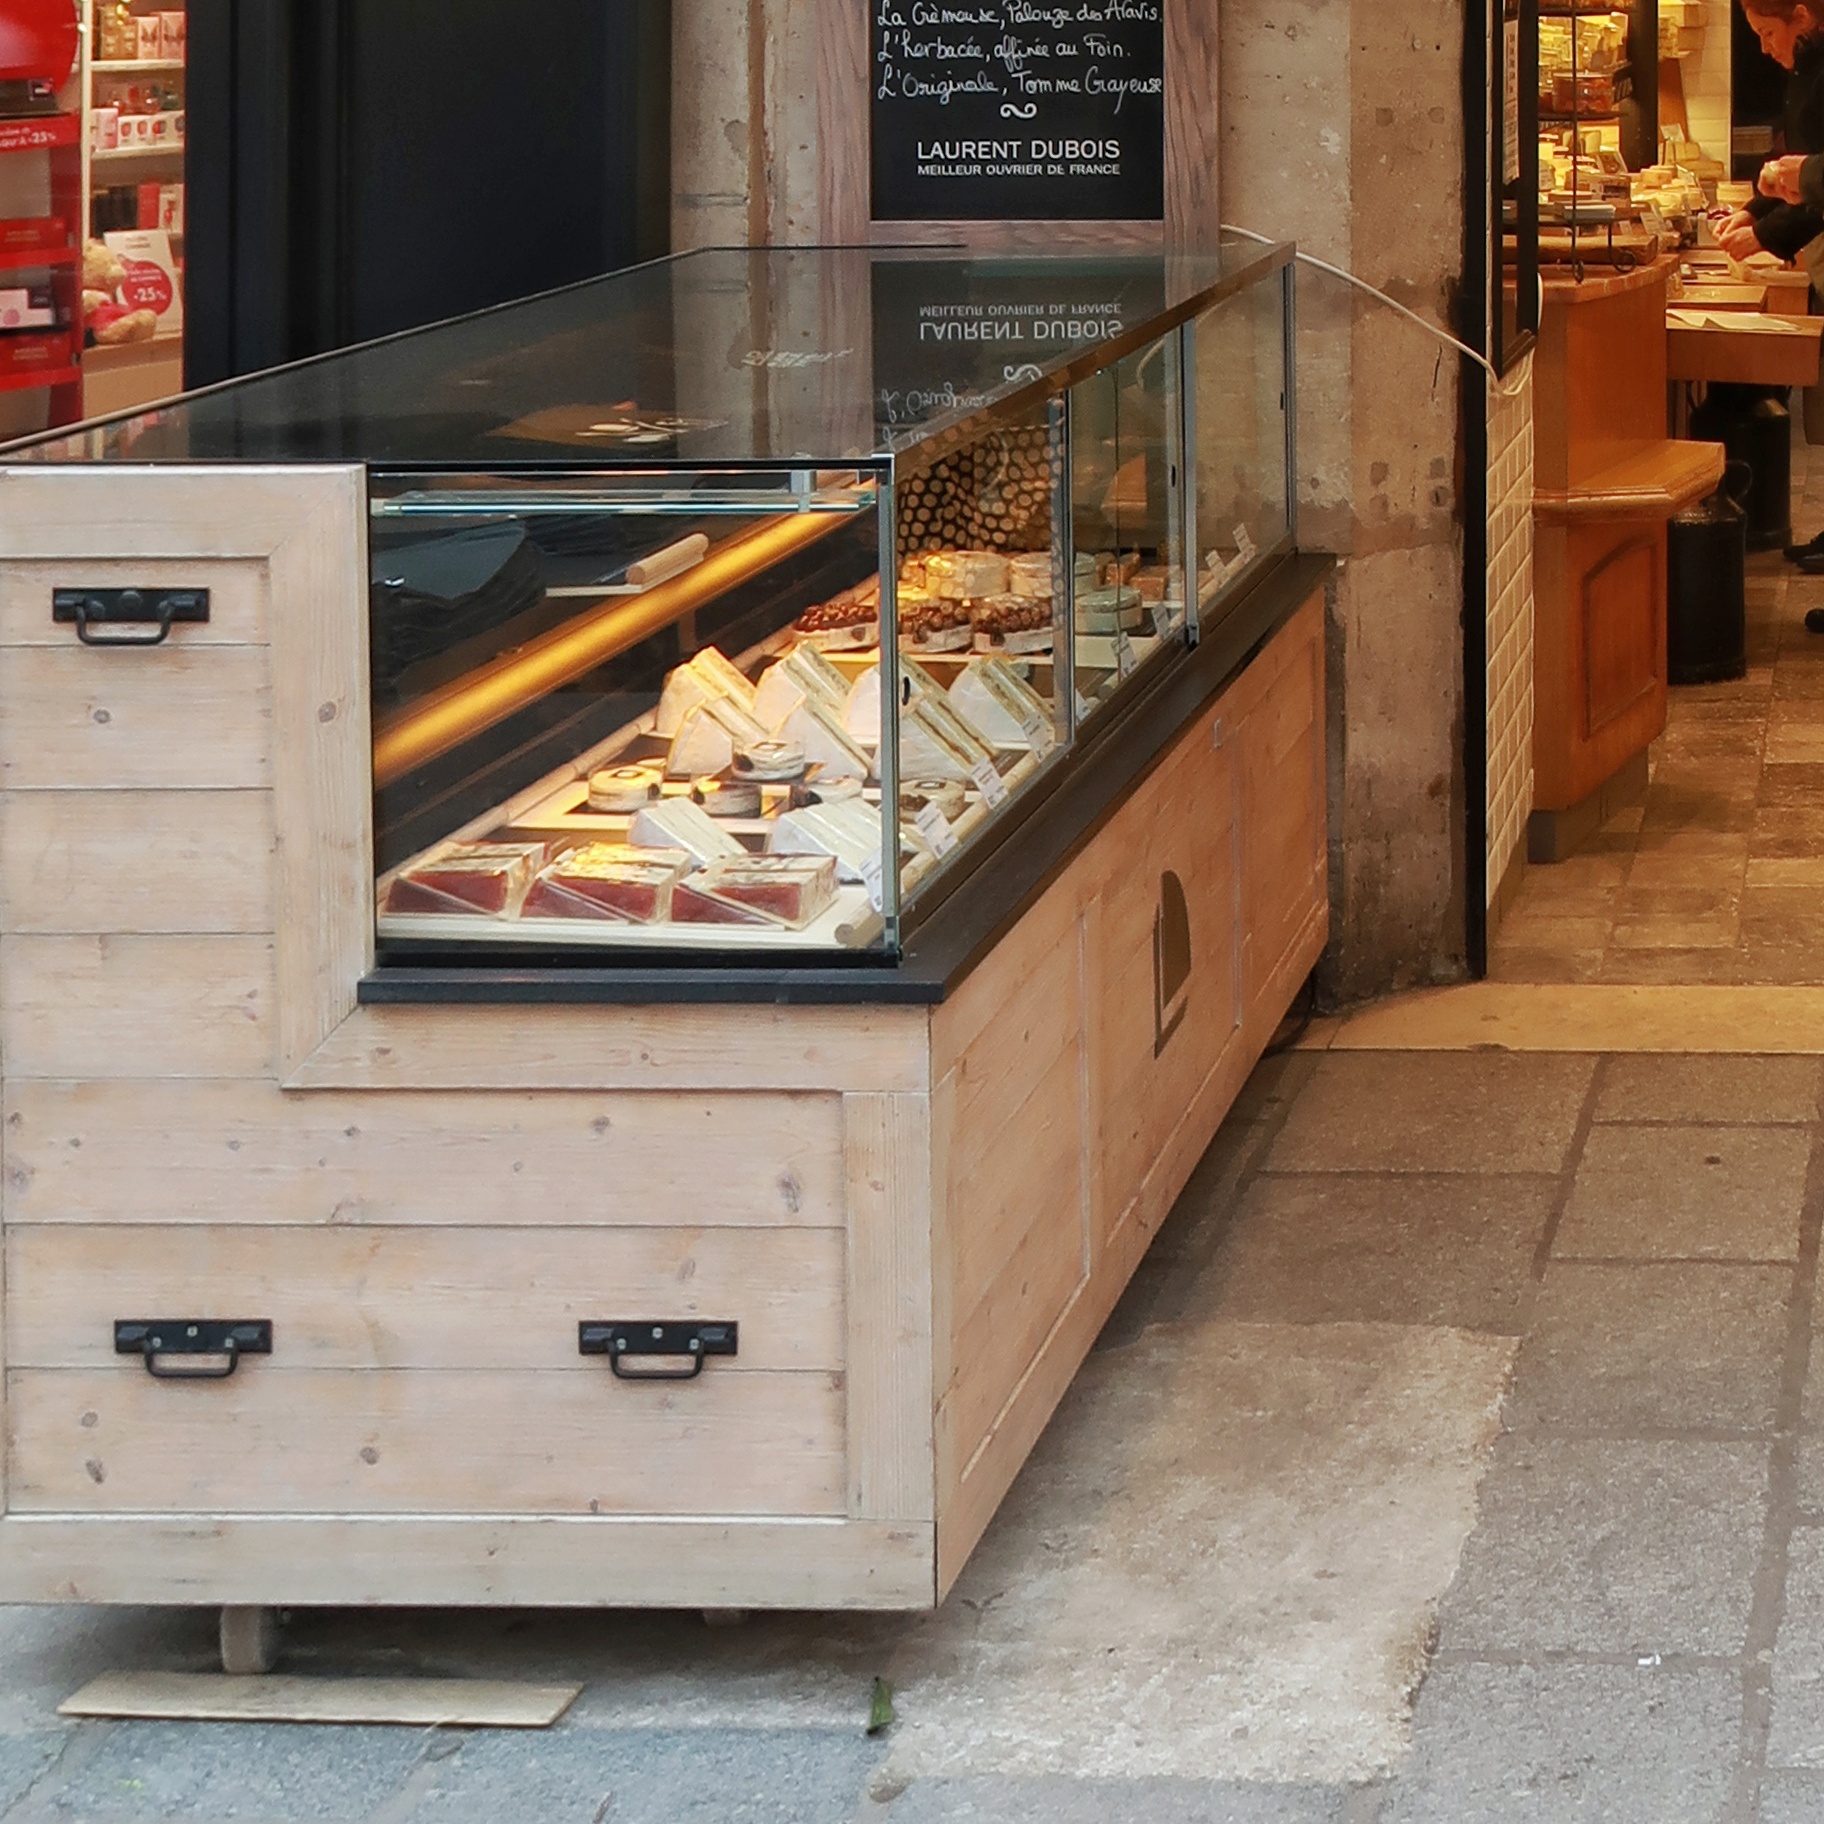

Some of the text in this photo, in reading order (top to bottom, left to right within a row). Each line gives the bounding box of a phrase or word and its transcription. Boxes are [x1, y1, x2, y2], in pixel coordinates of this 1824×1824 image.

[1076, 4, 1103, 22] des
[994, 34, 1050, 74] affinée
[1056, 42, 1078, 57] au
[1011, 70, 1081, 94] Tomme
[917, 140, 1121, 159] LAURENT DUBOIS
[917, 163, 1121, 176] MEILLEUR OUVRIER DE FRANCE
[133, 286, 167, 302] -25%
